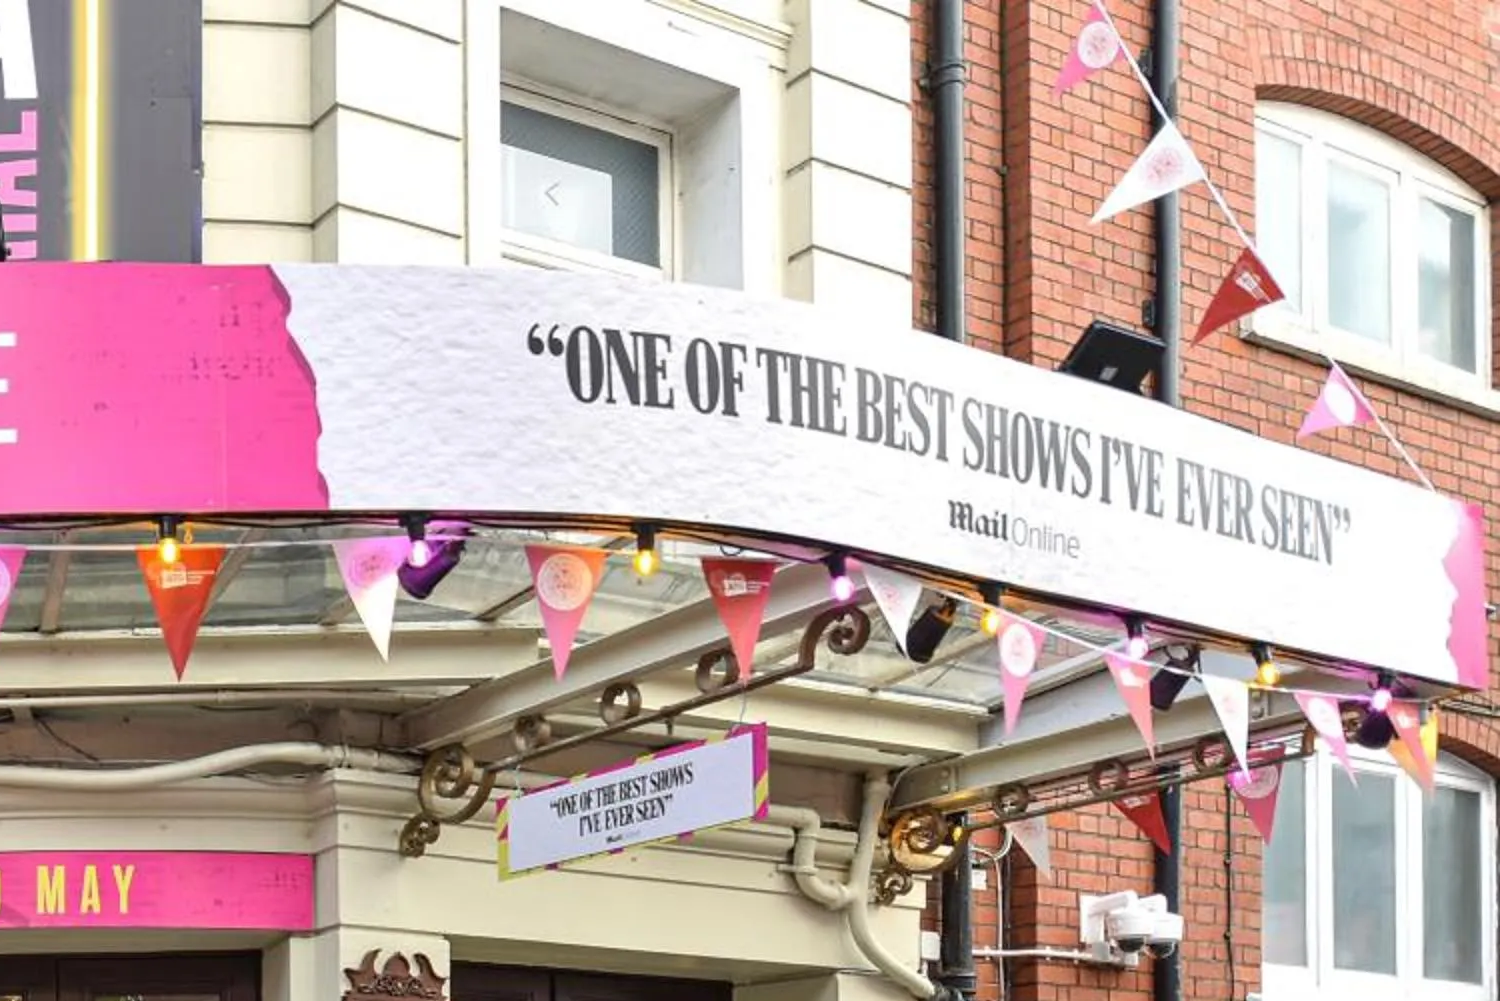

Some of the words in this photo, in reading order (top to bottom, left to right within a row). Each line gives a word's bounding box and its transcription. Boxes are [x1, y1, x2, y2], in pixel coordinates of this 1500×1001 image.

[527, 322, 675, 410] “ONE
[685, 337, 748, 418] OF
[756, 347, 848, 438] THE
[855, 366, 955, 463] BEST
[962, 397, 1093, 500] SHOWS
[1176, 454, 1256, 546] EVER
[1261, 483, 1352, 566] SEEN”
[579, 789, 593, 812] OF
[595, 783, 617, 809] THE
[619, 775, 649, 801] BEST
[649, 761, 695, 794] SHOWS
[604, 803, 634, 831] EVER
[36, 864, 136, 915] MAY
